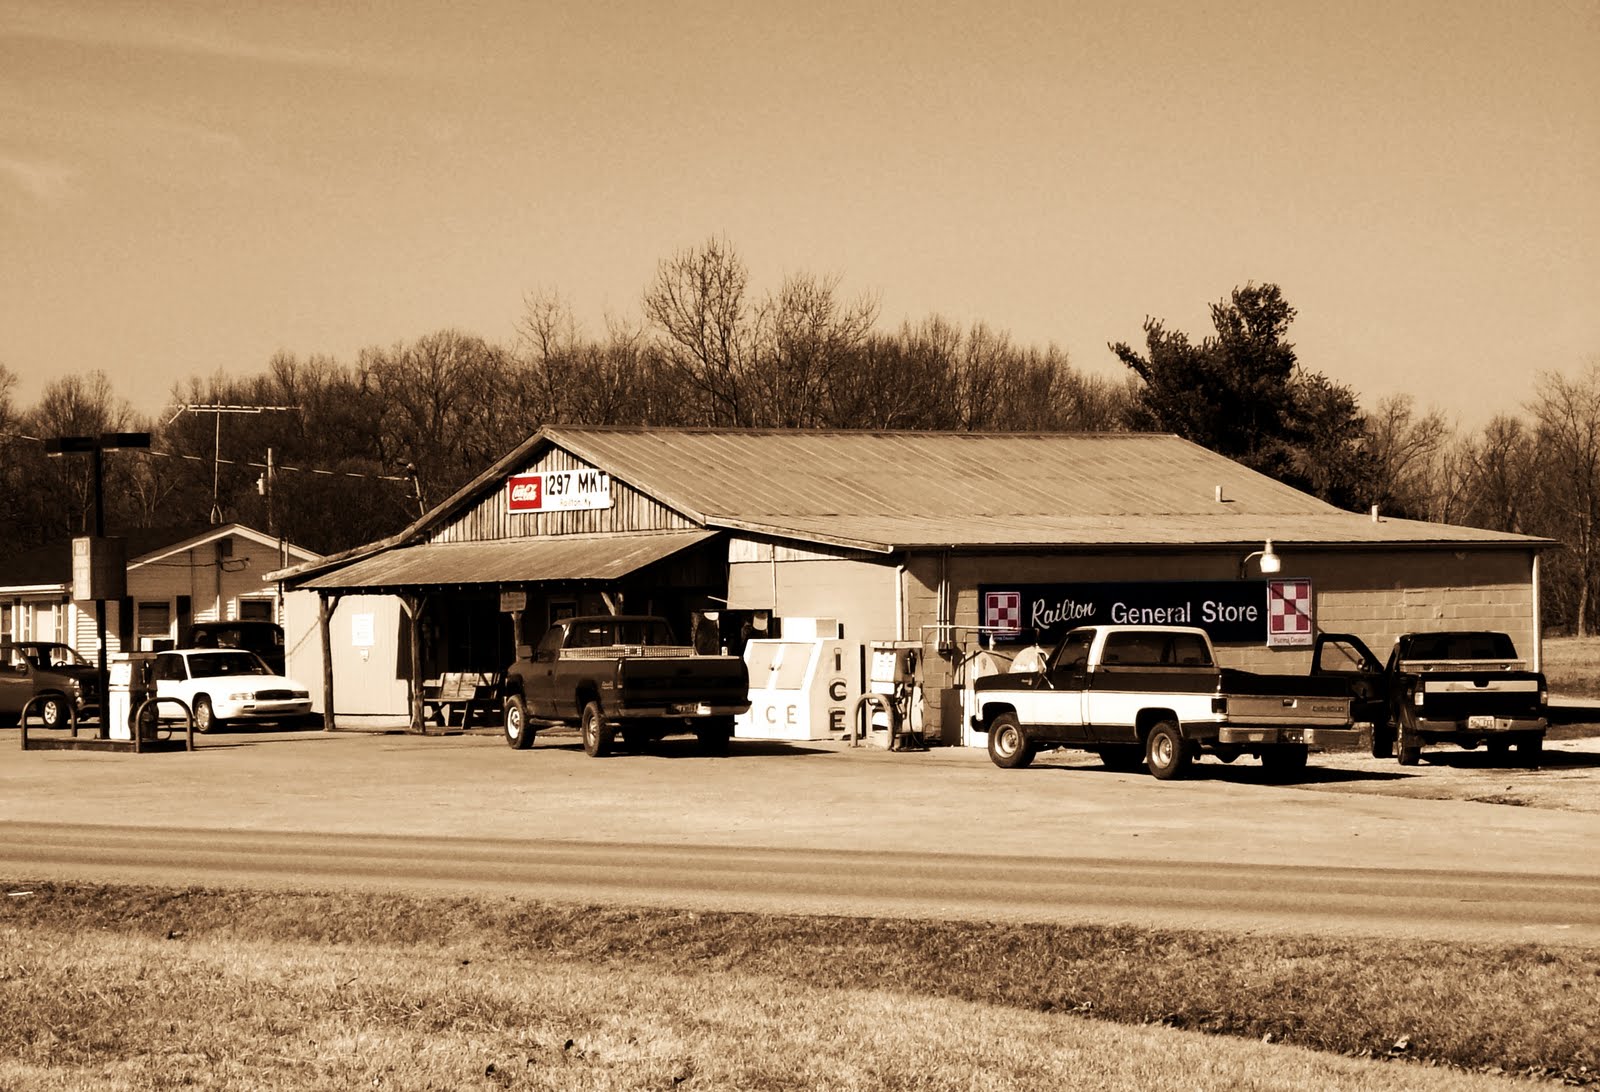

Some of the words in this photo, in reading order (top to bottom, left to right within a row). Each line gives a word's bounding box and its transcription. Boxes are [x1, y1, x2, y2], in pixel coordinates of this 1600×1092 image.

[545, 474, 571, 495] 1297
[578, 471, 608, 493] MKT.
[1032, 599, 1096, 629] Railton
[1111, 601, 1191, 624] General
[1202, 600, 1258, 623] Store
[750, 704, 797, 724] ICE
